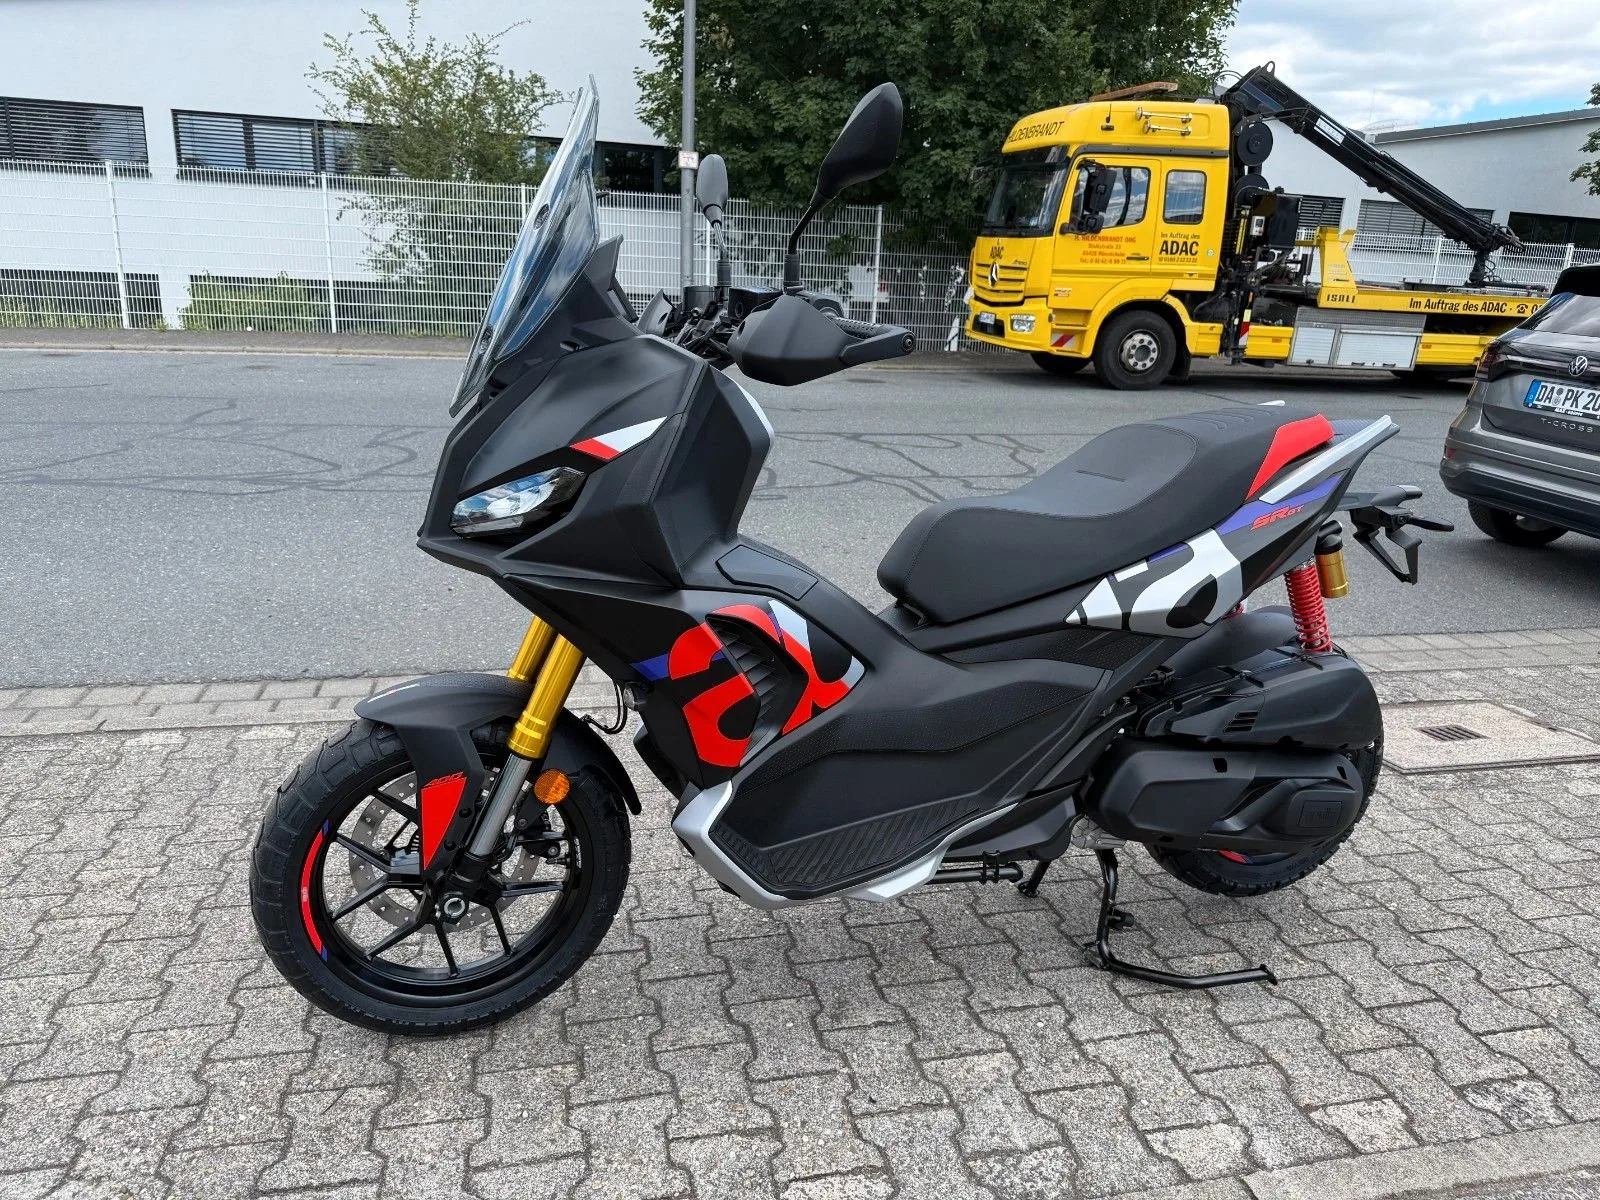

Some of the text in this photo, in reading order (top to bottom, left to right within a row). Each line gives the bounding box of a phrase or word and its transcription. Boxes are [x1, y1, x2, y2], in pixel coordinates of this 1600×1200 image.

[1170, 232, 1189, 240] Auftrag
[990, 246, 1004, 259] ADAC
[1159, 239, 1199, 256] ADAC
[1409, 298, 1421, 309] Im
[1424, 299, 1460, 312] Auftrag
[1462, 301, 1479, 312] des
[1480, 302, 1507, 313] ADAC
[1535, 385, 1555, 404] DA
[1562, 389, 1584, 409] PK
[1541, 417, 1593, 433] T-CROSS
